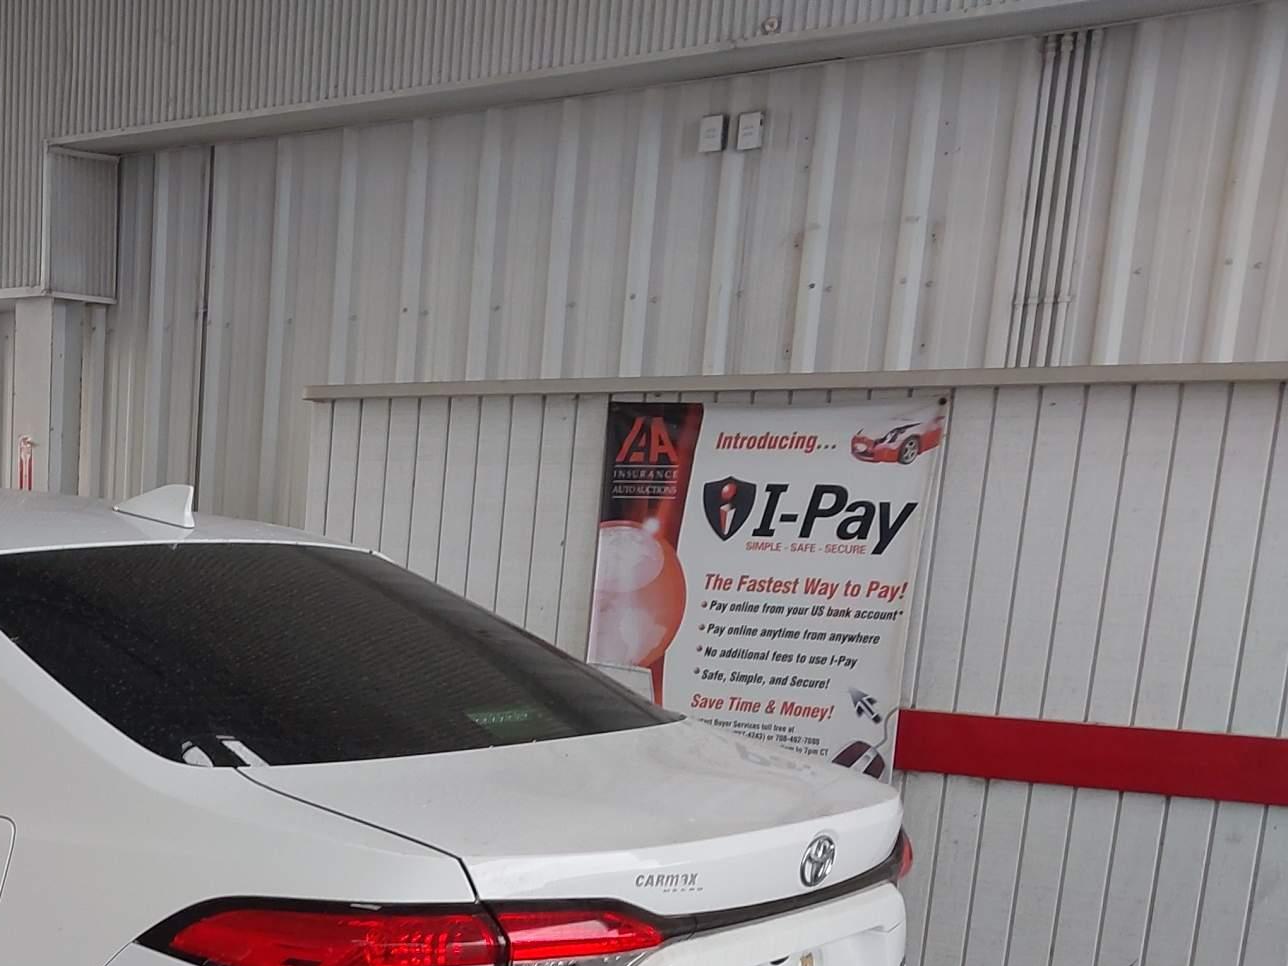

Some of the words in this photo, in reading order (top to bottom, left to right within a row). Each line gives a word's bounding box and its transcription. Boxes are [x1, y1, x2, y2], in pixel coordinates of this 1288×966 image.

[716, 432, 837, 454] Introducing...
[613, 470, 679, 479] INSURANCE
[612, 485, 636, 494] AUTO
[637, 485, 678, 495] AUCTIONS
[752, 484, 919, 555] I-Pay
[746, 541, 782, 552] SIMPLE
[790, 543, 816, 553] SAFE
[824, 544, 867, 554] SECURE
[705, 573, 733, 591] The
[737, 575, 799, 594] Fastest
[804, 577, 840, 600] Way
[844, 580, 861, 597] to
[866, 581, 908, 603] Pay!
[709, 600, 728, 613] Pay
[729, 601, 760, 613] online
[761, 603, 785, 614] from
[785, 606, 809, 617] your
[810, 605, 825, 616] US
[826, 606, 852, 618] bank
[706, 623, 726, 637] Pay
[727, 625, 758, 637] online
[760, 627, 800, 640] anytime
[803, 629, 827, 641] from
[829, 632, 880, 645] anywhere
[704, 646, 718, 658] No
[719, 648, 770, 660] additional
[771, 650, 793, 662] fees
[796, 653, 807, 663] to
[808, 655, 828, 665] use
[829, 655, 858, 670] I-Pay
[701, 668, 727, 682] Safe,
[729, 671, 766, 686] Simple,
[769, 675, 789, 686] and
[789, 675, 831, 690] Secure!
[691, 694, 724, 710] Save
[728, 696, 761, 713] Time
[765, 700, 776, 714] &
[780, 701, 835, 722] Money!
[733, 720, 760, 730] Services
